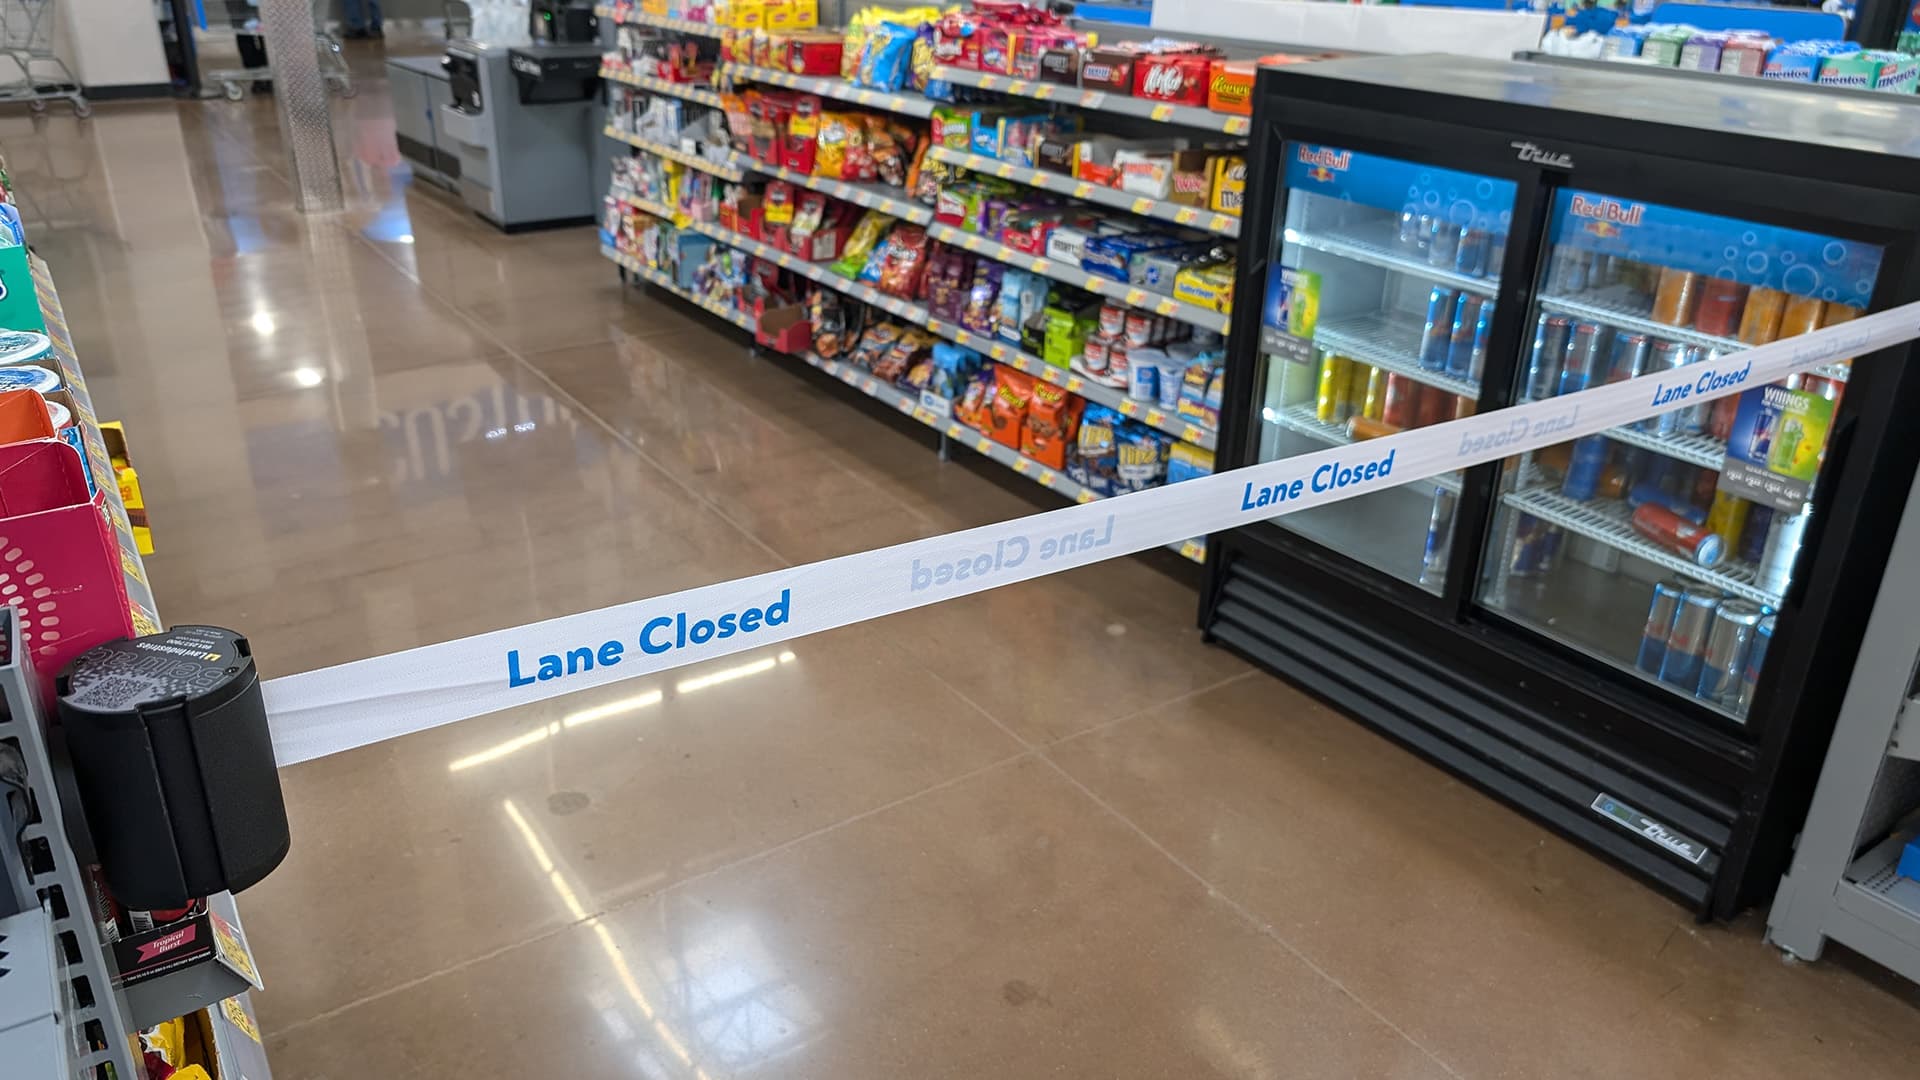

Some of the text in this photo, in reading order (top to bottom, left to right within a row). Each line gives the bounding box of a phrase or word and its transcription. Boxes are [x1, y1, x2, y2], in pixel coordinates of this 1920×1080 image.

[1763, 69, 1809, 79] mentos
[1820, 74, 1867, 86] mentos
[1297, 144, 1350, 172] Red Bull
[1570, 194, 1644, 226] Red Bull
[1652, 360, 1752, 406] Lane Closed
[1763, 386, 1809, 411] WIIINGS
[1241, 448, 1396, 511] Lane Closed
[136, 641, 186, 658] Industries
[507, 588, 791, 688] Lane Closed
[152, 930, 185, 949] Tropical
[159, 940, 181, 954] Burst
